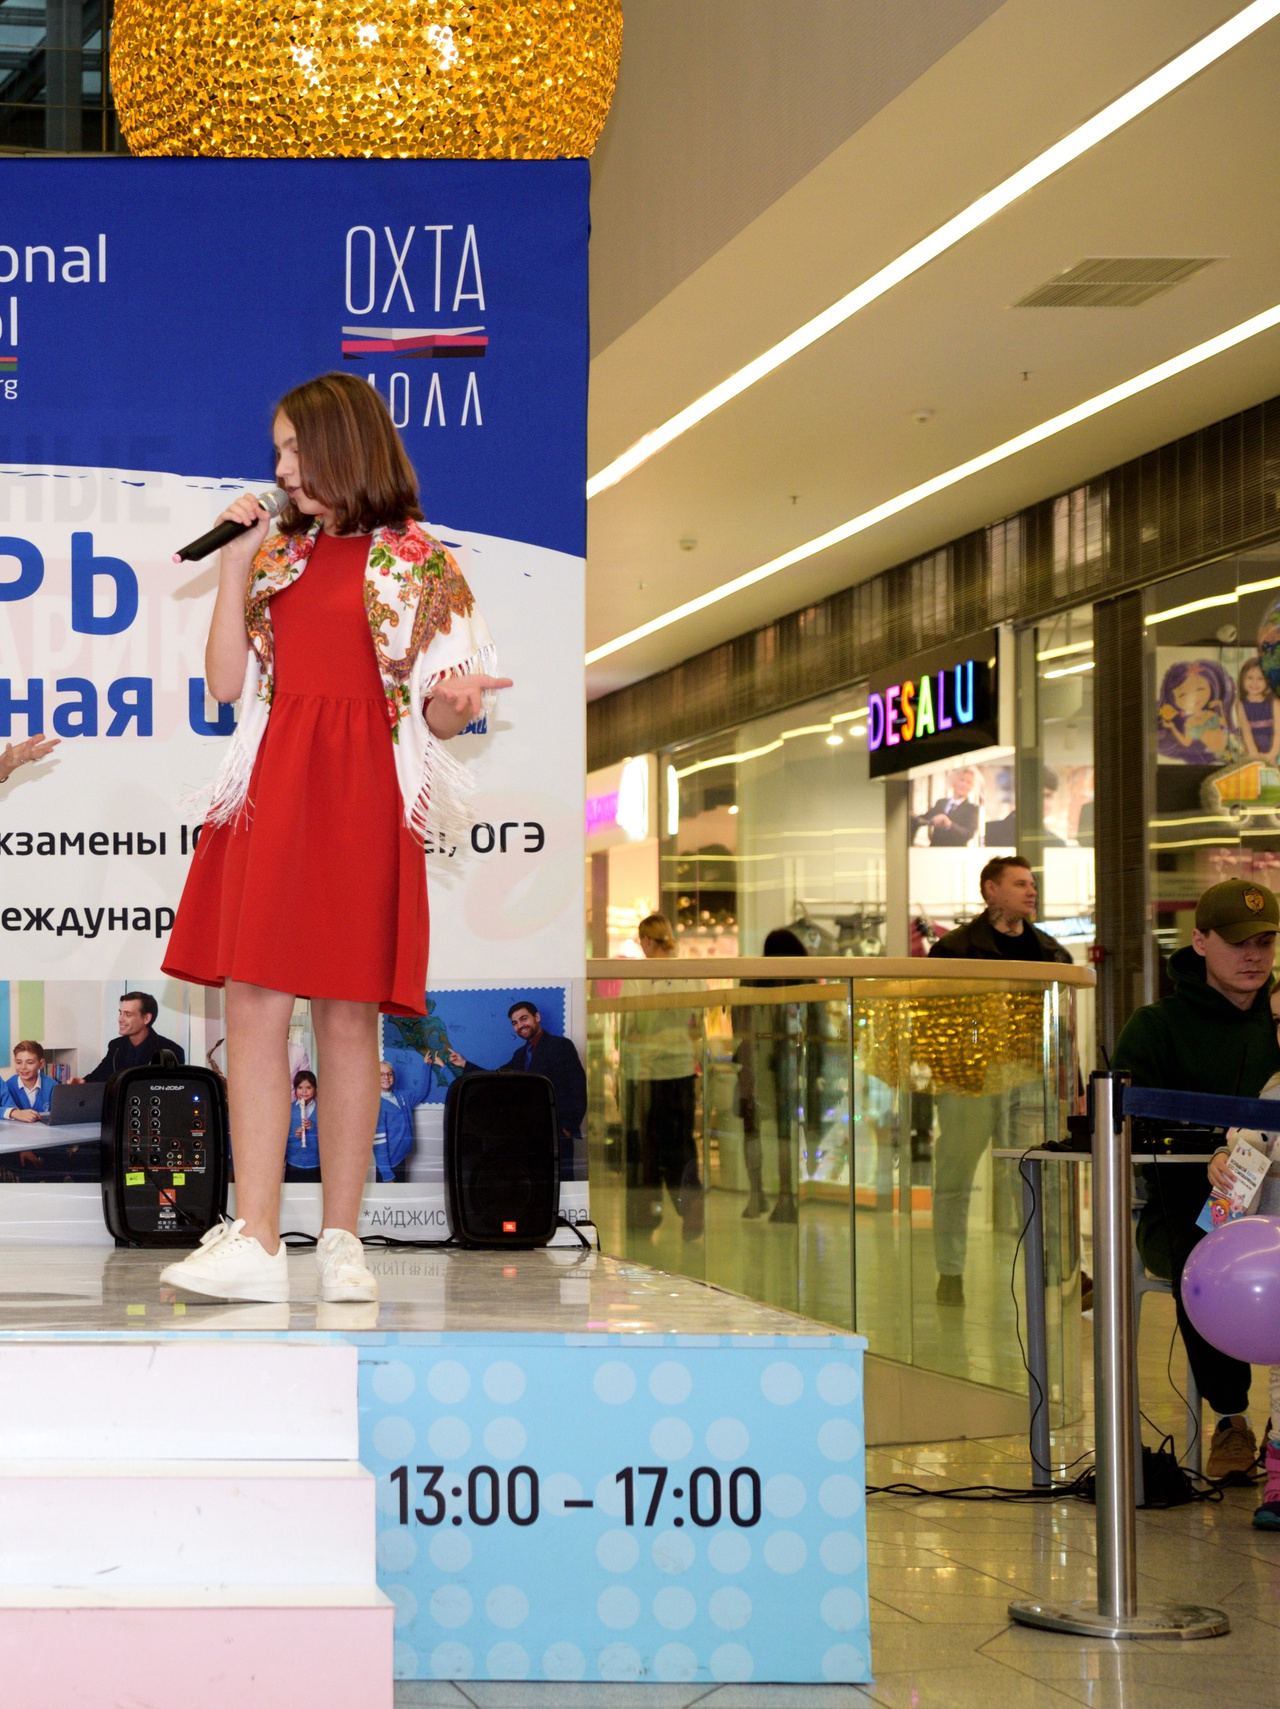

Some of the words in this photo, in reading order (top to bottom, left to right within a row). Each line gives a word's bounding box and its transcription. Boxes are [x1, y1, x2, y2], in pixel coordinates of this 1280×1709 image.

[344, 223, 486, 316] ОХТА
[367, 371, 484, 429] ОЛЛ
[867, 659, 974, 752] DESALU
[469, 821, 546, 855] ОГЭ
[363, 1206, 446, 1229] АЙДЖИС
[389, 1464, 541, 1528] 13:00
[614, 1465, 762, 1528] 17:00
